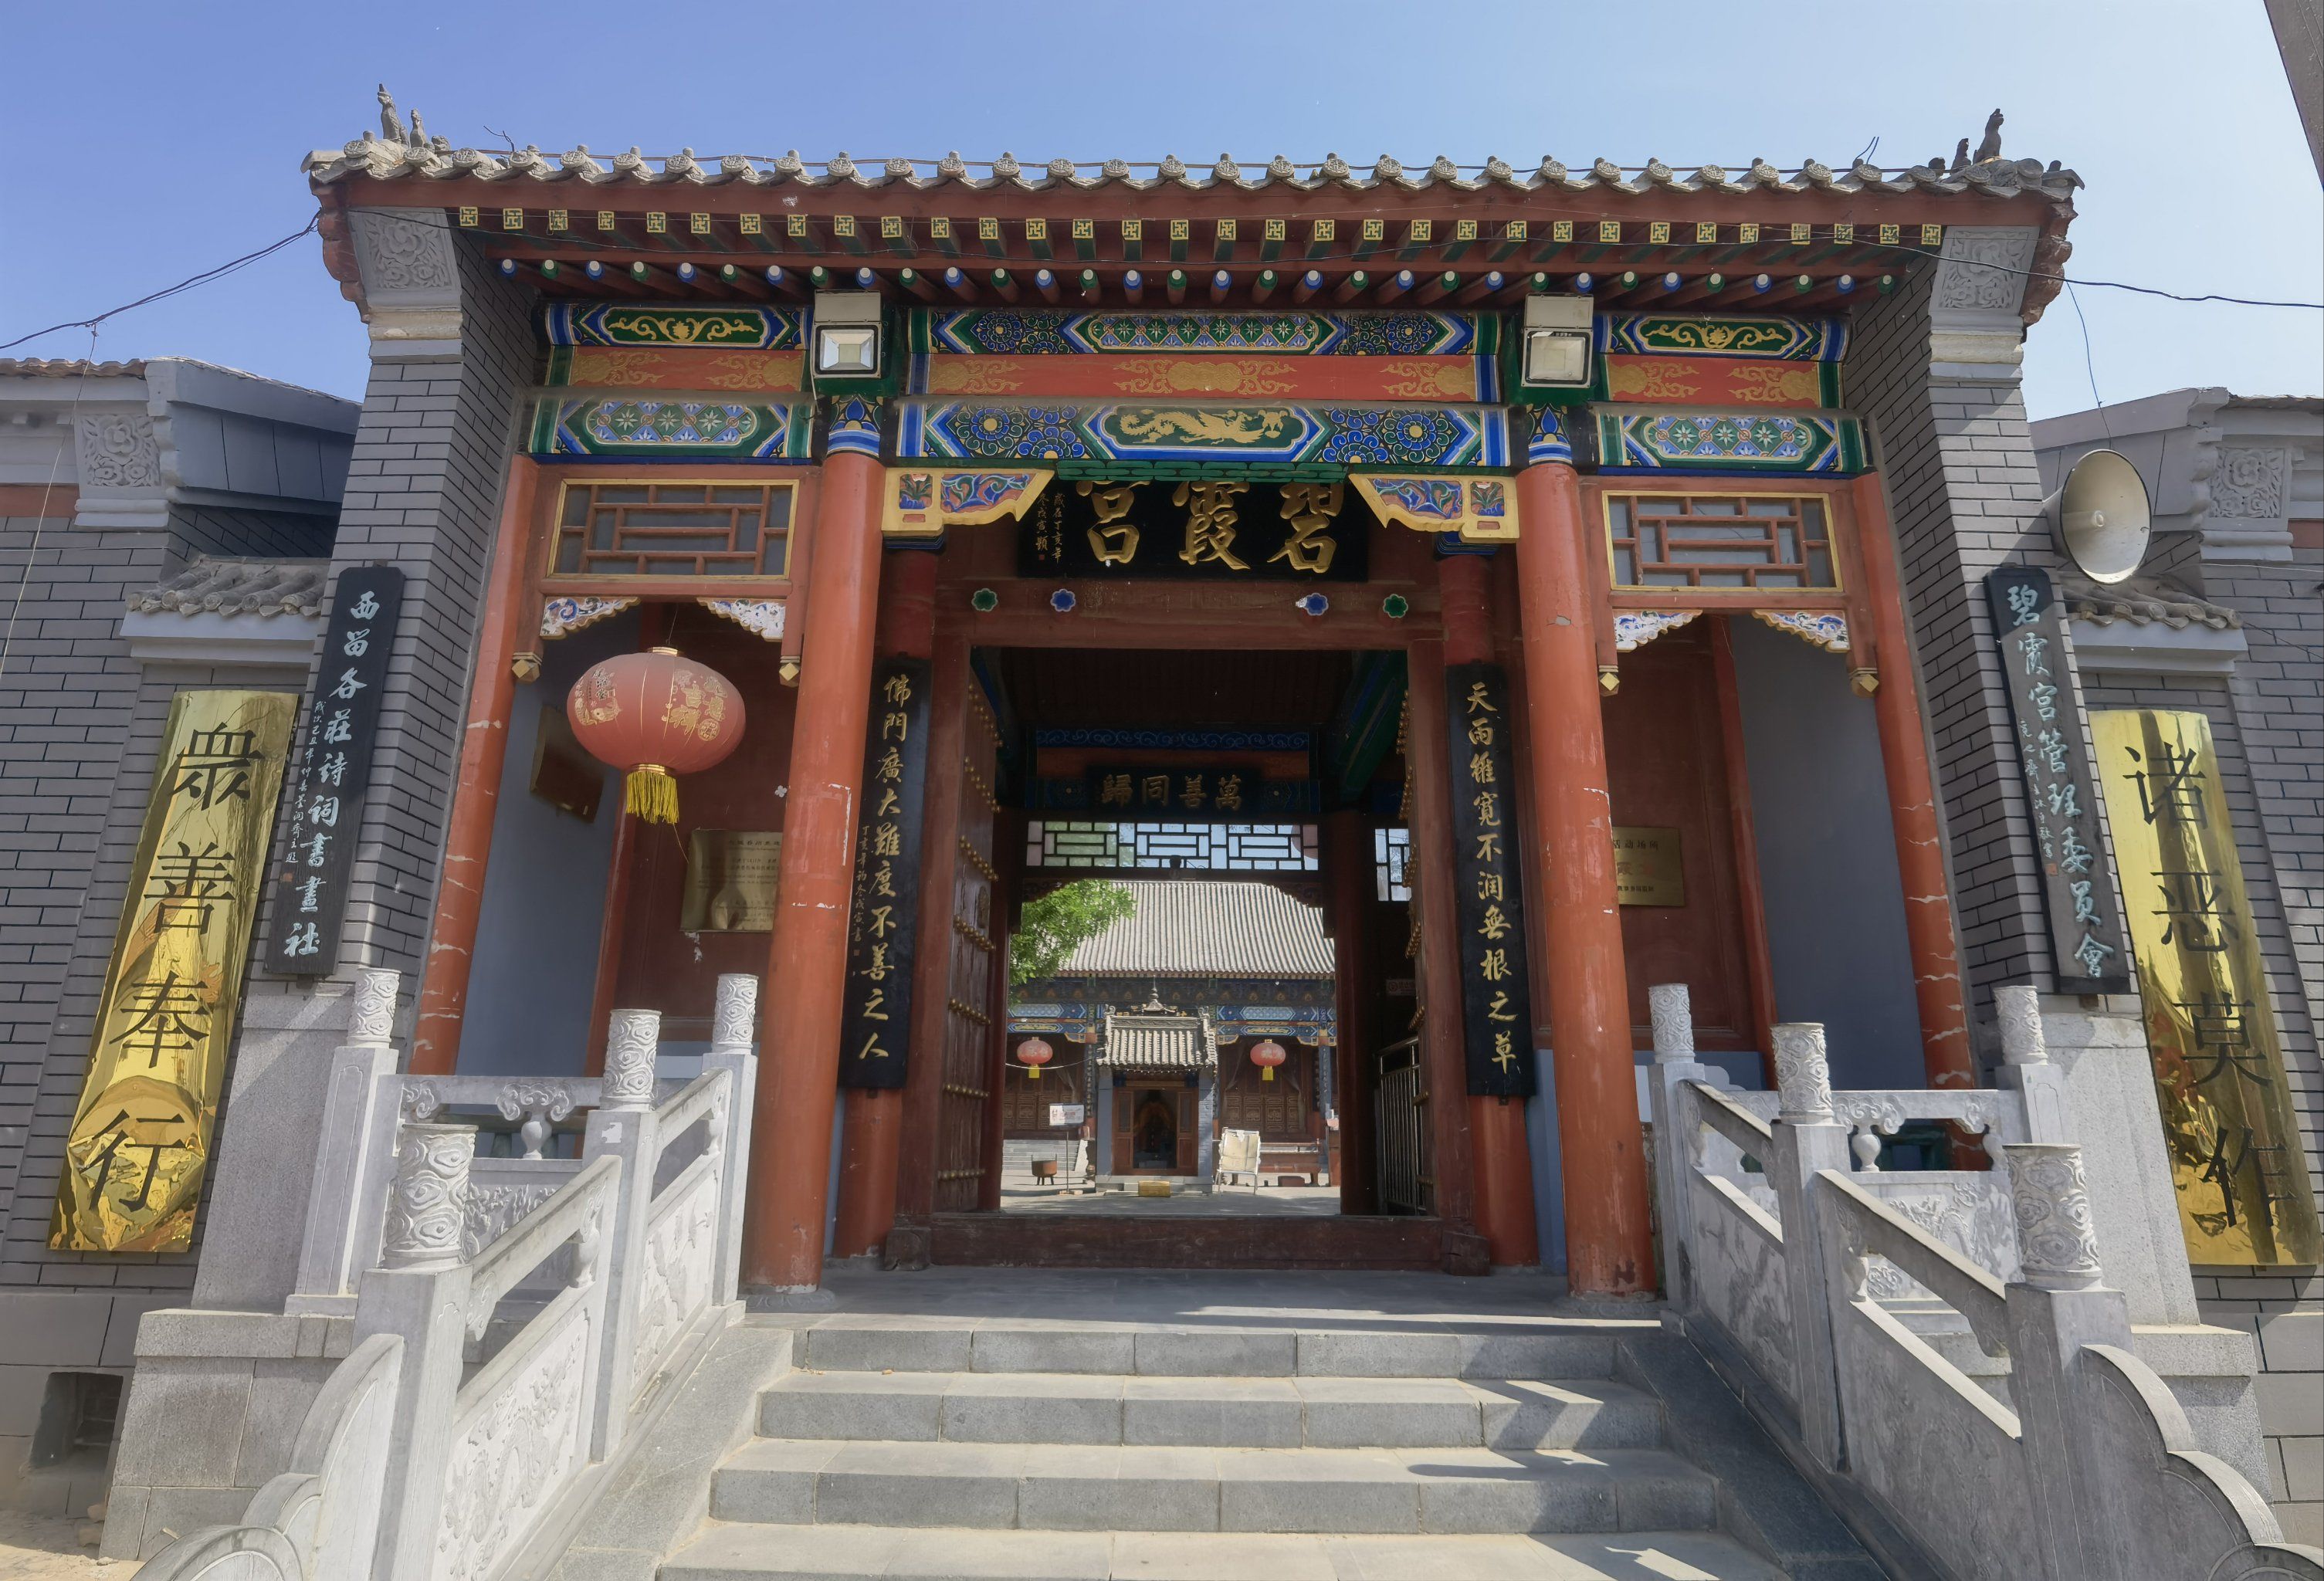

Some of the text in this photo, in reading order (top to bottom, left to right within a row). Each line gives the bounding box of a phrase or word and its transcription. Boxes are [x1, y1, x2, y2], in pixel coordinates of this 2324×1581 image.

[1102, 774, 1242, 811] 萬善同歸
[2122, 742, 2295, 1229] 诸恶莫作
